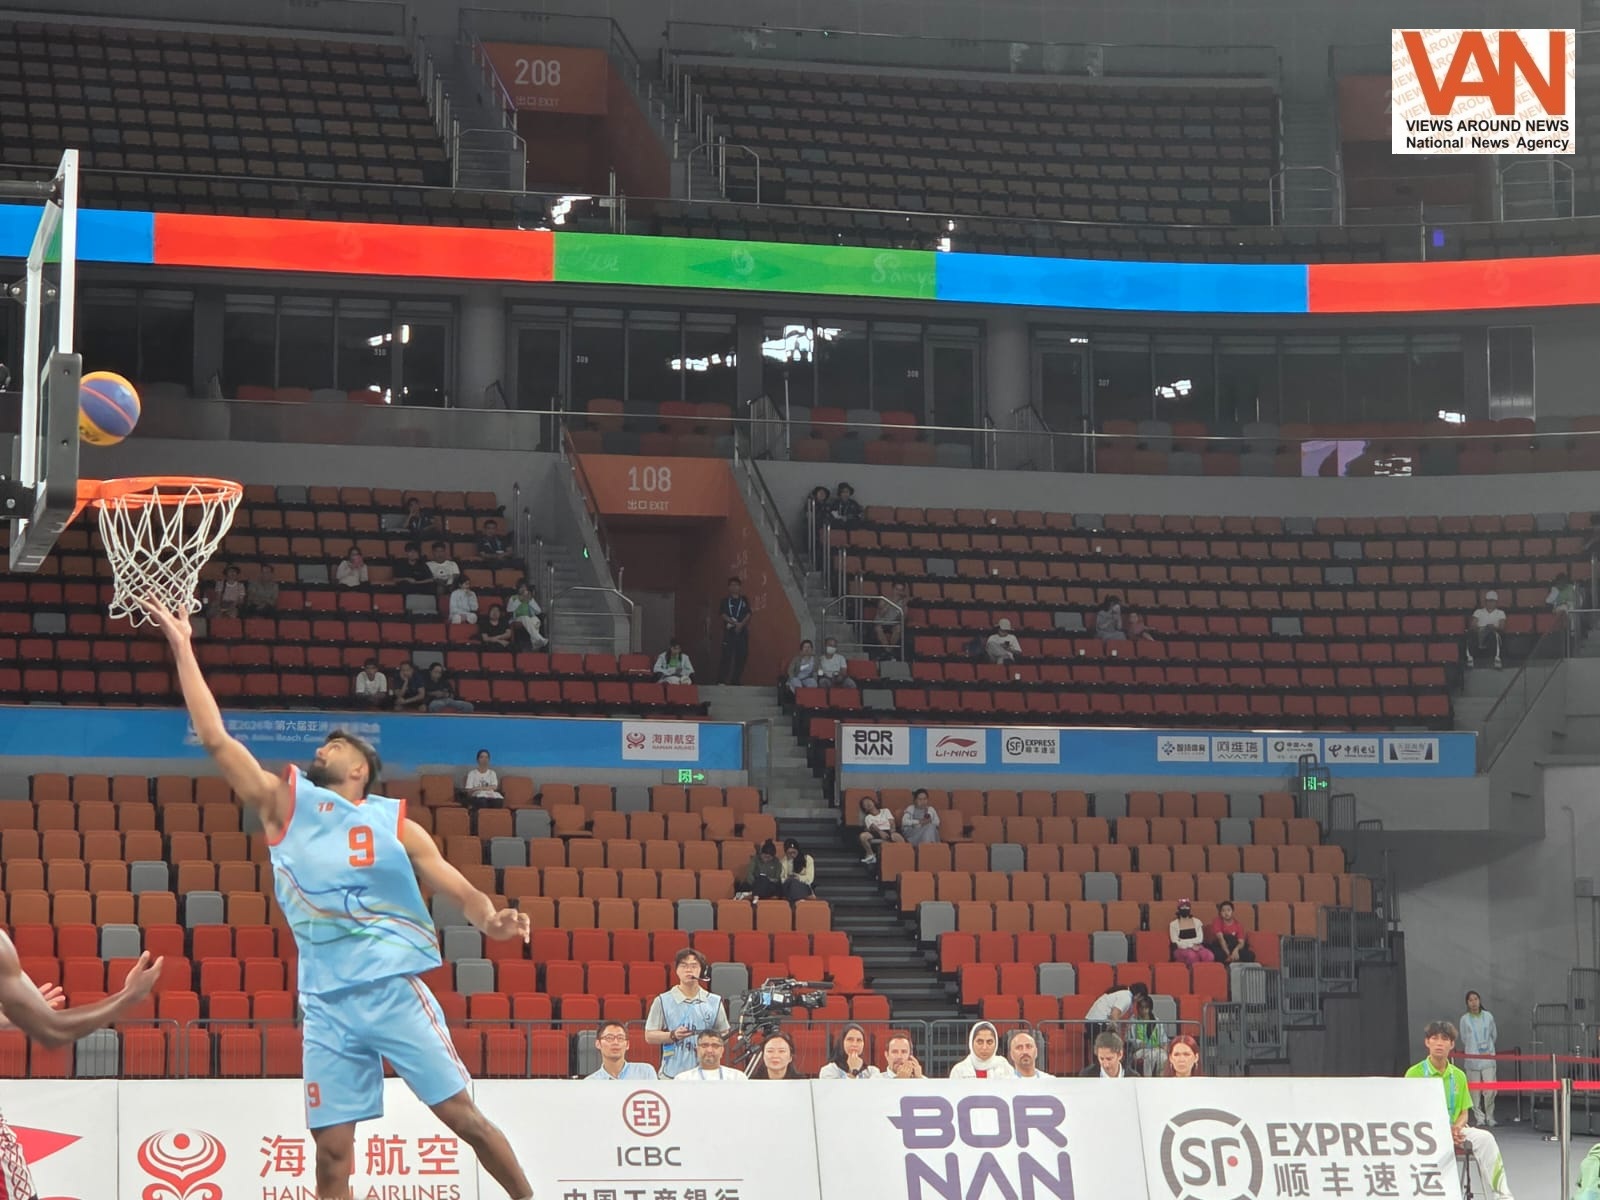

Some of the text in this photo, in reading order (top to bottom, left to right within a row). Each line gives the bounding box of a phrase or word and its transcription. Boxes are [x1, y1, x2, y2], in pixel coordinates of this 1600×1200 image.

[515, 58, 561, 86] 208
[628, 465, 672, 492] 108
[627, 498, 670, 511] 出口 EXIT
[652, 734, 695, 745] 海南航空
[852, 729, 893, 743] BOR
[1025, 739, 1056, 747] EXPRESS
[854, 743, 893, 756] NAN
[935, 750, 977, 758] LI-NING
[349, 824, 375, 868] 9
[307, 1082, 321, 1108] 9
[886, 1095, 1068, 1149] BOR
[1266, 1121, 1438, 1157] EXPRESS
[260, 1134, 460, 1178] 海航空
[617, 1146, 682, 1167] ICBC
[905, 1151, 1075, 1200] NAN
[1273, 1161, 1447, 1198] 顺丰速运
[366, 1184, 461, 1200] AIRLINES
